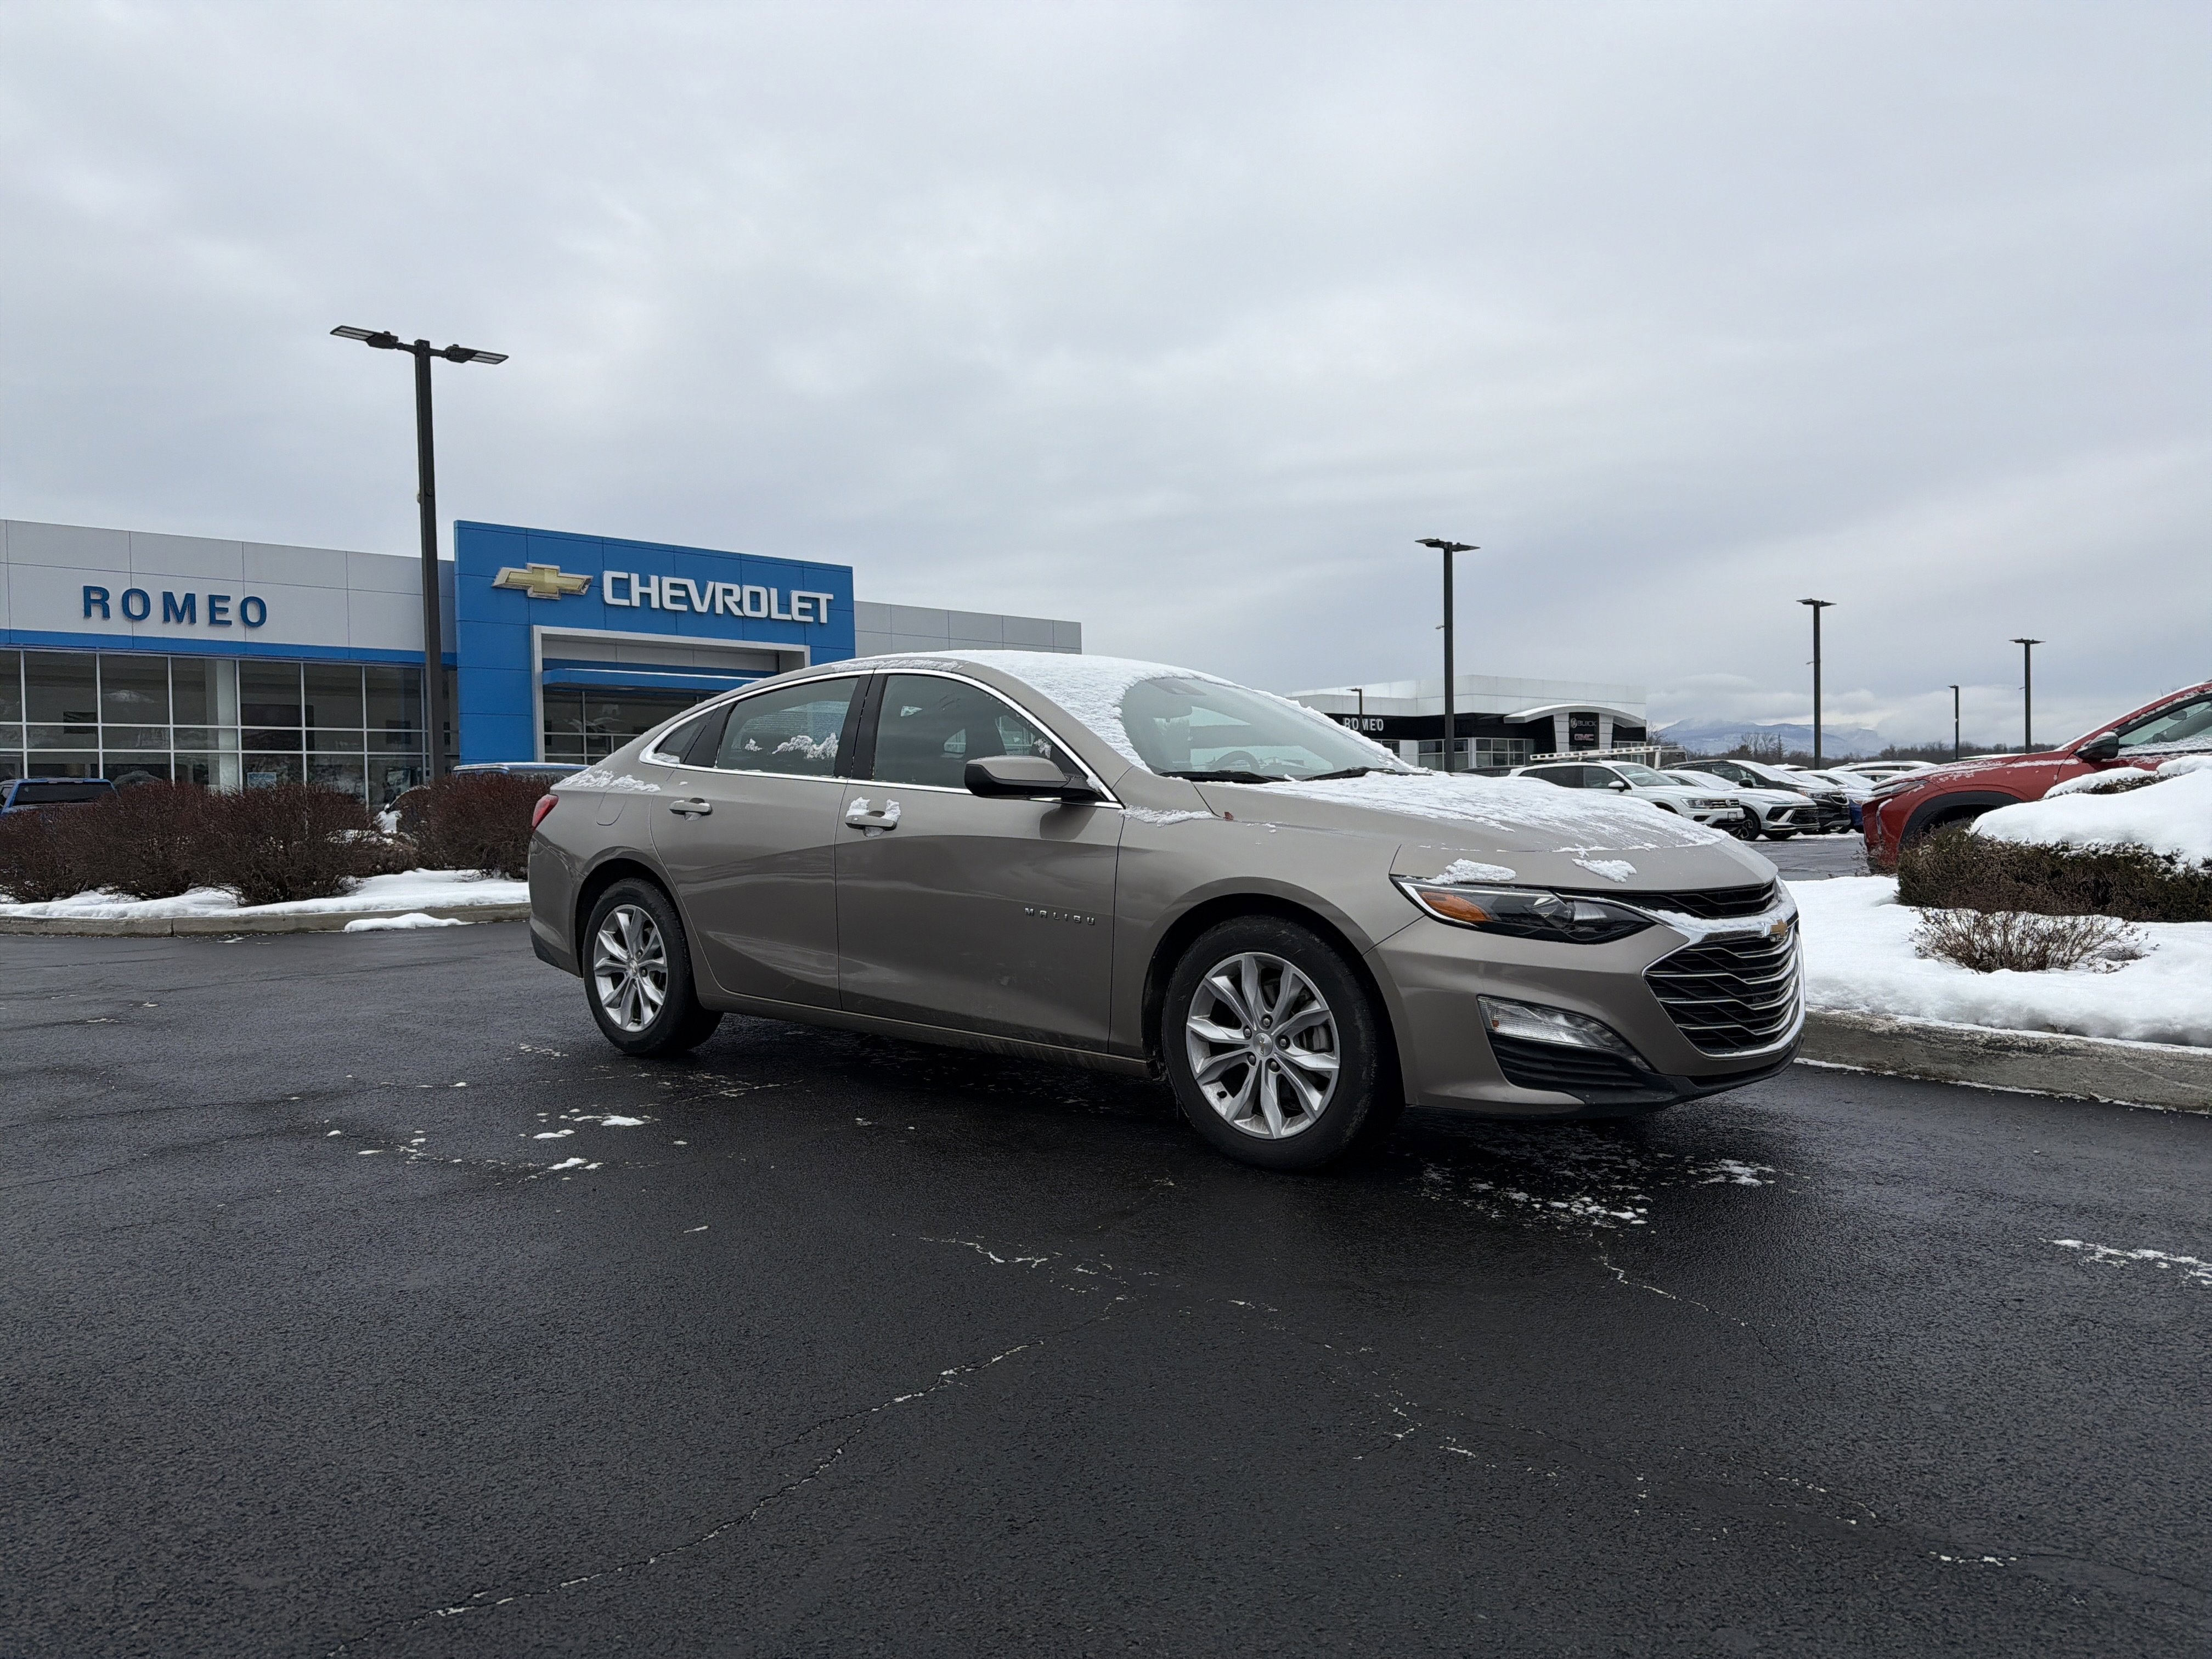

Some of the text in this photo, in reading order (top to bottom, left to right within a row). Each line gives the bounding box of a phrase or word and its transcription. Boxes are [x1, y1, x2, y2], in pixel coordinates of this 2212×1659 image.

[83, 585, 267, 628] ROMEO
[603, 571, 834, 624] CHEVROLET
[1343, 718, 1384, 731] ROMEO
[1025, 907, 1095, 926] MALIBU
